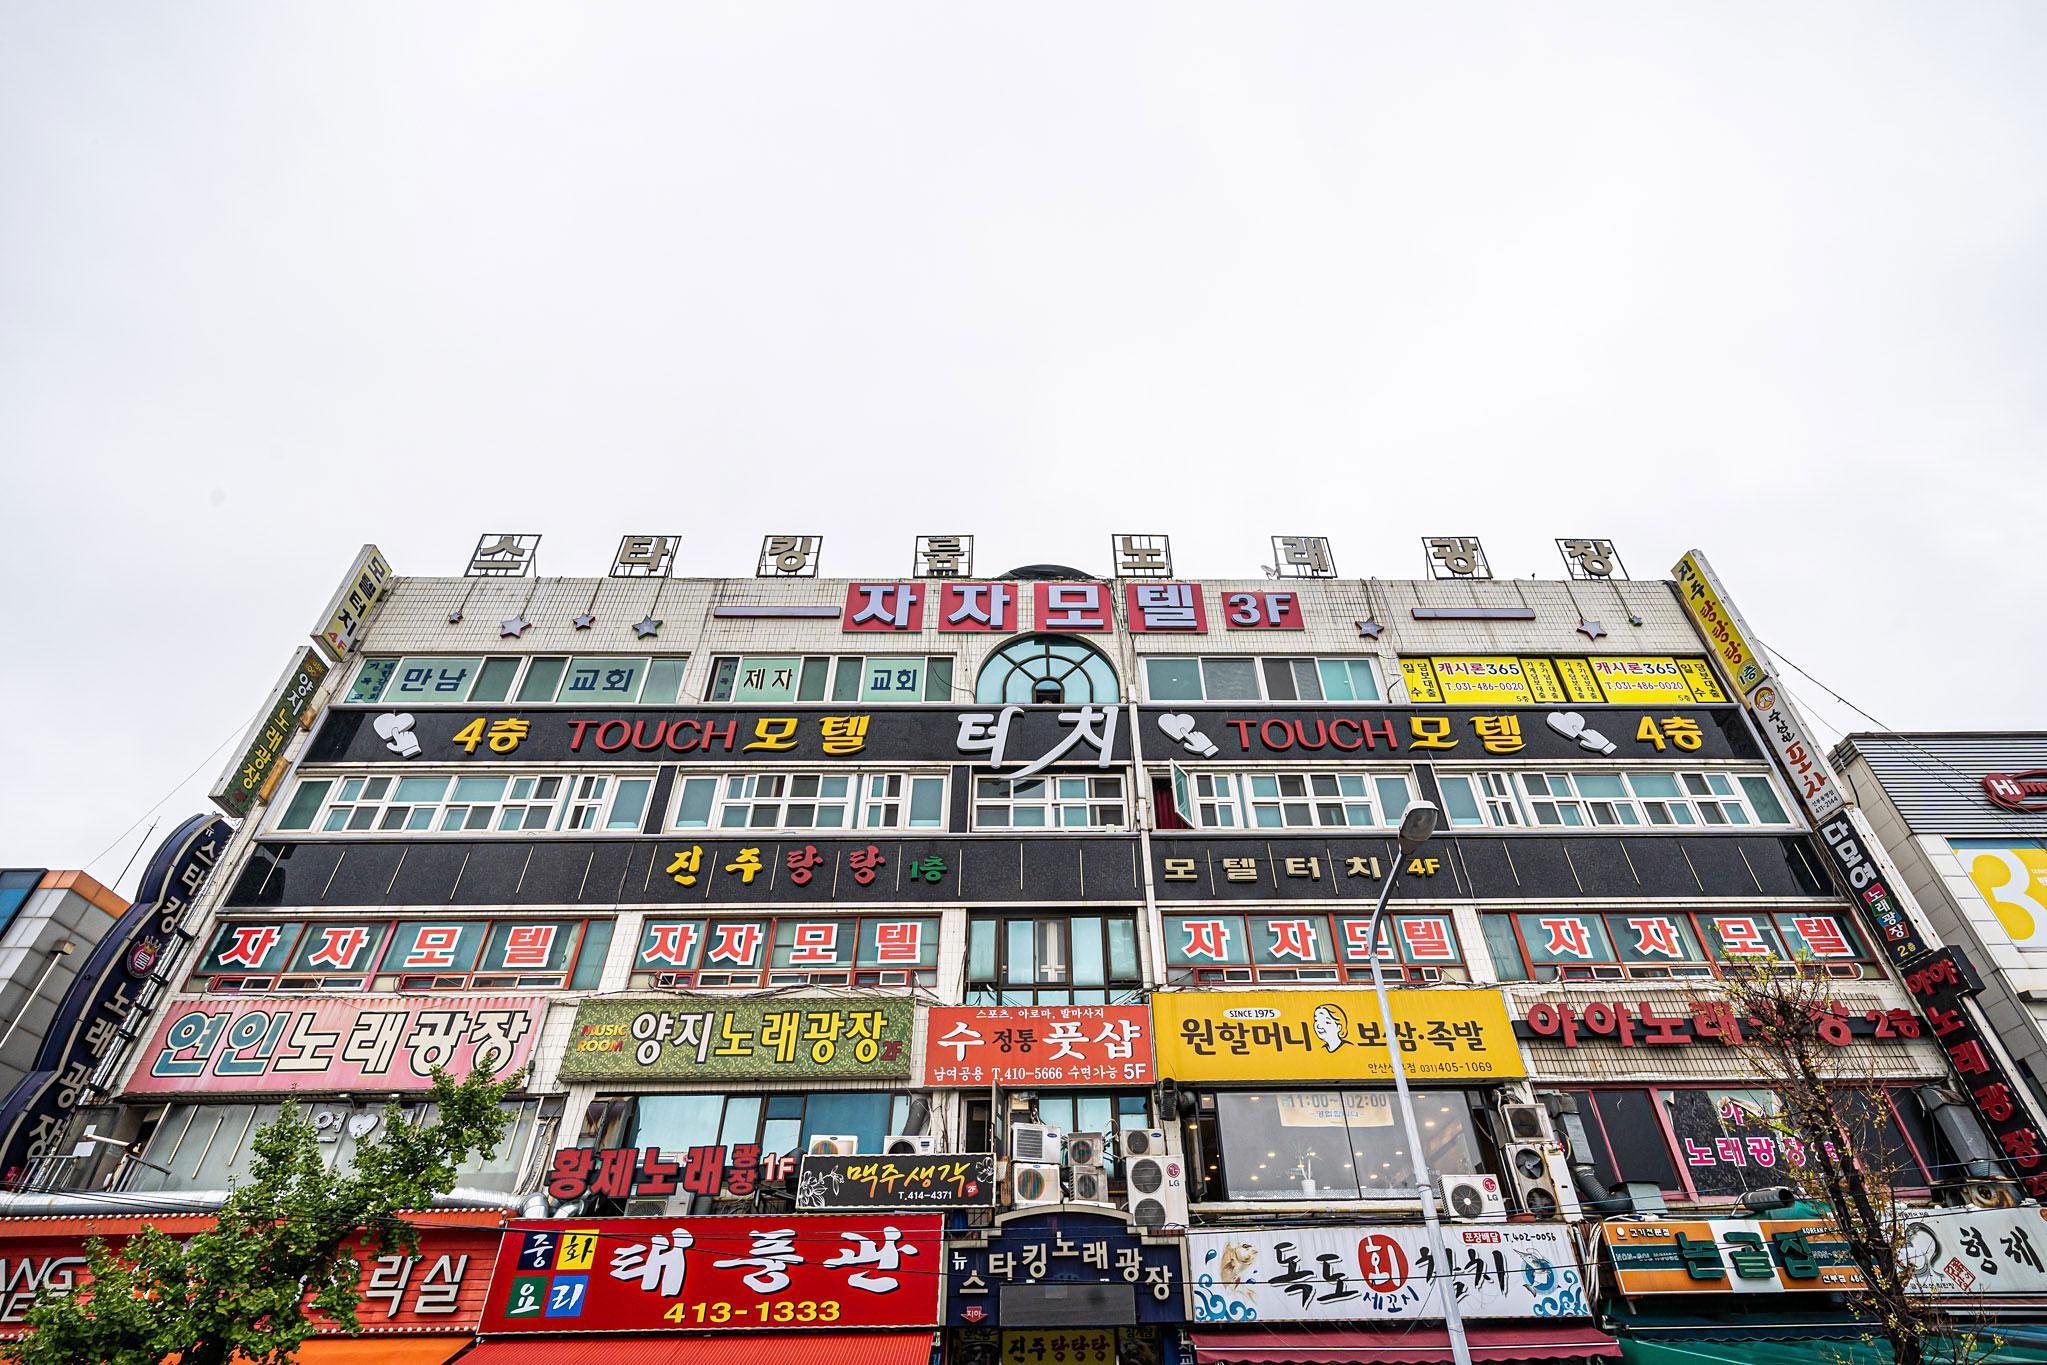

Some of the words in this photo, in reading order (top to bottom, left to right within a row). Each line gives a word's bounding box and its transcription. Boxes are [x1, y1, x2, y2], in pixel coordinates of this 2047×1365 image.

[852, 584, 1197, 630] 자자모텔
[1227, 592, 1293, 627] 3F
[400, 668, 468, 692] 만남
[568, 669, 635, 693] 교회
[743, 668, 793, 691] 제자
[870, 668, 917, 693] 교회
[451, 716, 531, 755] 4층
[567, 718, 738, 752] TOUCH
[742, 714, 871, 756] 모텔
[956, 704, 1119, 782] 터치
[1226, 718, 1399, 751] TOUCH
[1408, 714, 1527, 756] 모텔
[1636, 715, 1704, 753] 4층
[1406, 858, 1441, 877] 4F
[218, 924, 559, 969] 자자모텔
[642, 921, 922, 966] 자자모텔
[1060, 1008, 1105, 1019] 발마사지
[1229, 1010, 1253, 1018] SINCE
[1254, 1009, 1276, 1018] 1975
[1866, 1007, 1921, 1039] 2층
[580, 1024, 628, 1038] MUSIC
[936, 1021, 986, 1062] 수
[991, 1027, 1038, 1053] 정통
[1180, 1018, 1312, 1056] 원할머니
[577, 1039, 623, 1052] ROOM
[880, 1041, 903, 1062] 2F
[933, 1066, 985, 1081] 남여공용
[991, 1067, 1063, 1082] T.410-5666
[1067, 1065, 1118, 1080] 수면가능
[1123, 1063, 1147, 1079] 5F
[763, 1152, 797, 1182] 1F
[846, 1161, 971, 1200] 맥주생각
[967, 1185, 978, 1193] 2F
[1168, 1179, 1180, 1187] LG
[898, 1191, 952, 1201] T.414-4371
[1486, 1193, 1499, 1202] LG
[522, 1232, 595, 1268] 중화
[1503, 1232, 1557, 1244] T.402-0056
[1959, 1225, 2046, 1276] 형제
[608, 1226, 920, 1297] 태풍관
[951, 1251, 968, 1271] 뉴
[509, 1282, 585, 1317] 요리
[663, 1300, 841, 1325] 413-1333
